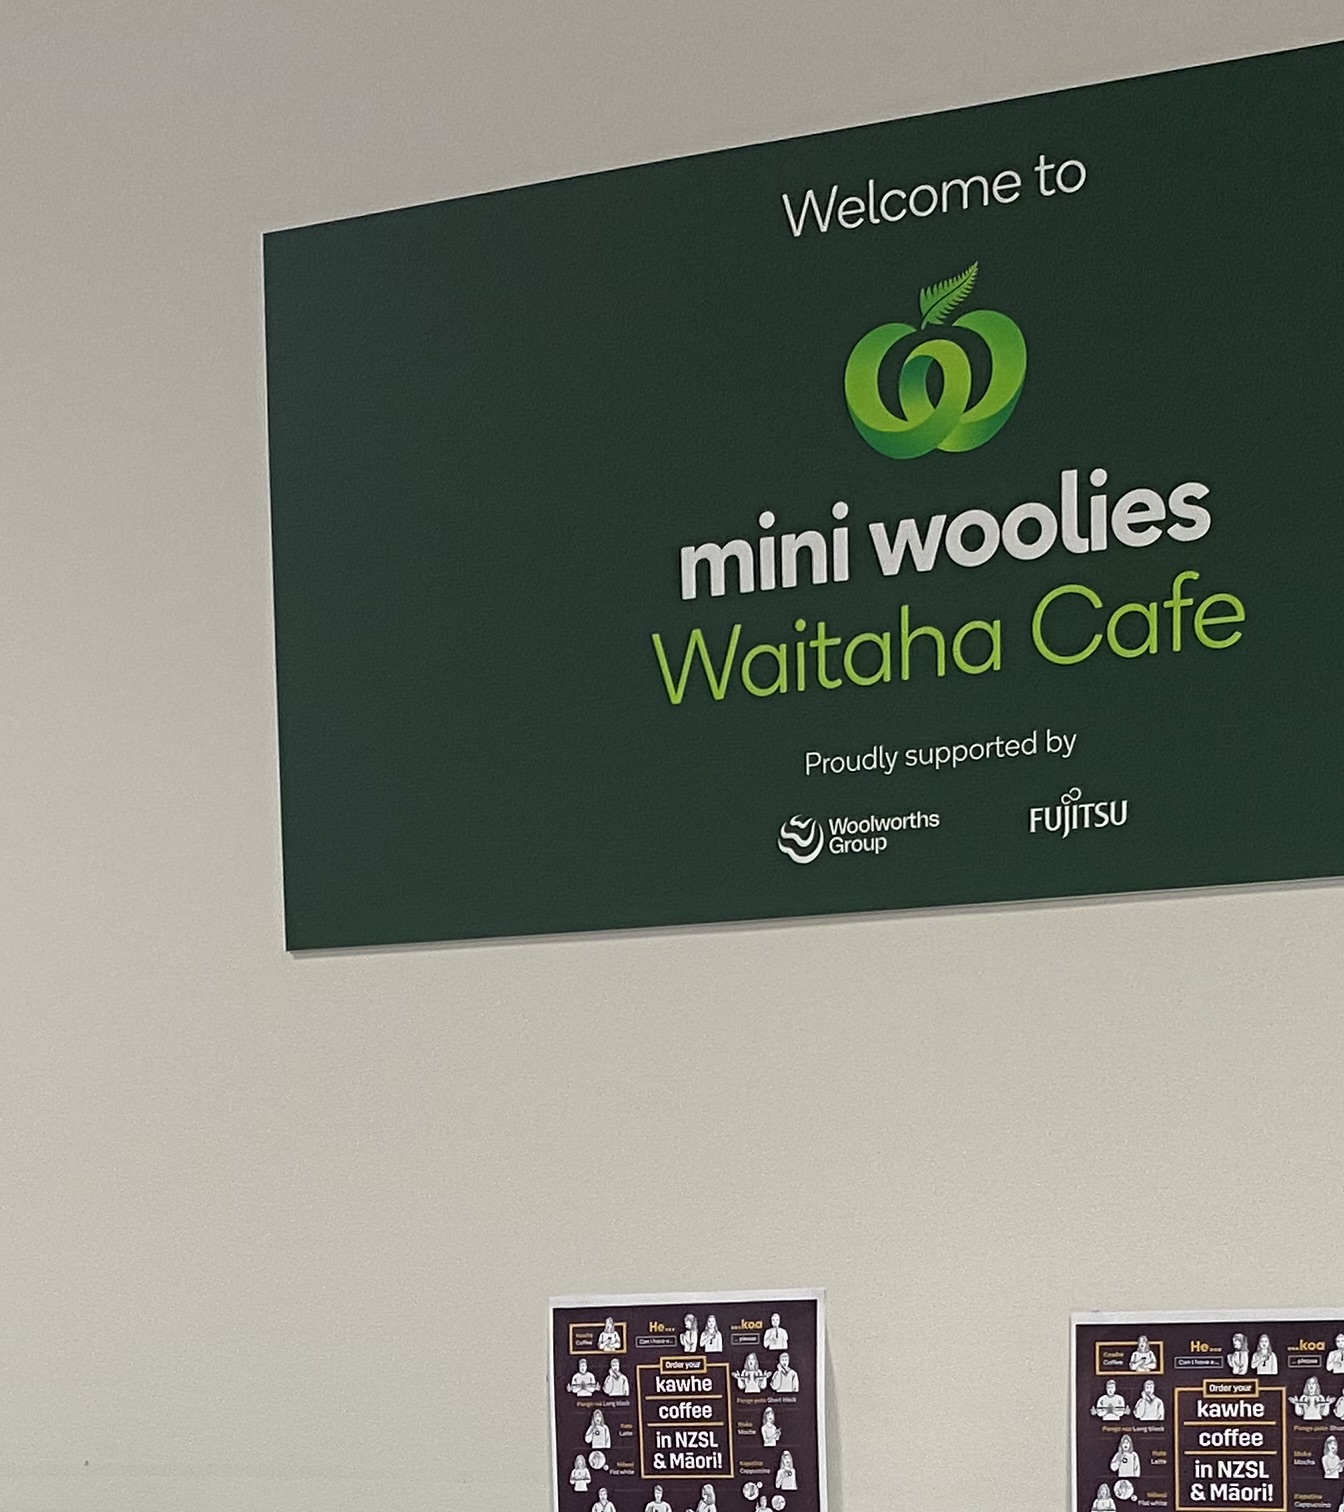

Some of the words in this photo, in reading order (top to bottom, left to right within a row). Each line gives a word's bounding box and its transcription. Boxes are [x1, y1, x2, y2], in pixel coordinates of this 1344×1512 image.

[782, 160, 1023, 238] Welcome
[1033, 151, 1088, 199] to
[680, 500, 850, 601] mini
[868, 467, 1213, 578] woolies
[650, 603, 1005, 706] Waitaha
[1030, 570, 1247, 665] Cafe
[804, 745, 899, 776] Proudly
[904, 728, 1038, 770] supported
[1045, 727, 1078, 758] by
[1028, 787, 1129, 839] FUJITSU
[828, 810, 941, 836] Woolworths
[828, 834, 888, 854] Group
[665, 1361, 683, 1370] Order
[684, 1361, 702, 1371] your
[656, 1375, 713, 1393] kawhe
[1209, 1384, 1230, 1393] Order
[1231, 1384, 1252, 1394] your
[658, 1402, 713, 1420] coffee
[1197, 1400, 1265, 1418] kawhe
[656, 1431, 671, 1449] in
[675, 1431, 719, 1448] NZSL
[1199, 1428, 1264, 1447] coffee
[653, 1453, 667, 1470] &
[670, 1451, 723, 1470] Māori!
[1194, 1460, 1213, 1479] in
[1217, 1460, 1270, 1479] NZSL
[1190, 1484, 1206, 1502] &
[1209, 1482, 1273, 1502] Māori!
